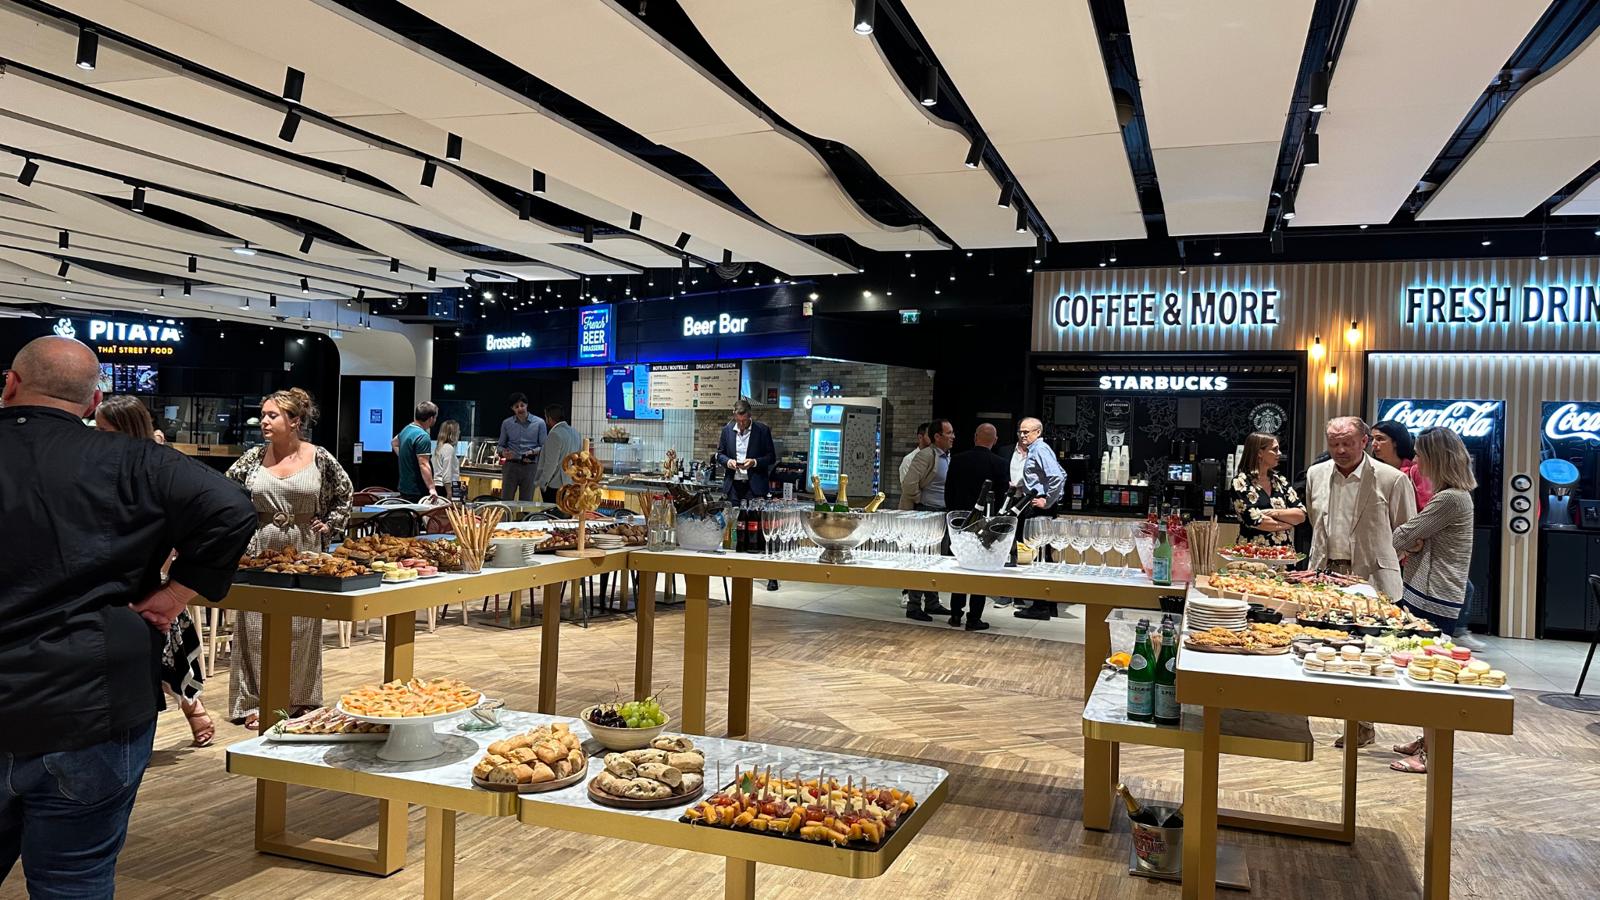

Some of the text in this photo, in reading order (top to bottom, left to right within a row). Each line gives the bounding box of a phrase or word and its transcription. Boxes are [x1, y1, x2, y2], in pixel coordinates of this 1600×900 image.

[1054, 290, 1278, 328] COFFEE & MORE
[1406, 286, 1511, 323] FRESH
[89, 320, 181, 341] PITAYA
[683, 313, 749, 337] Beer Bar
[486, 332, 532, 351] Brasserie
[583, 330, 605, 345] BEER
[118, 346, 148, 355] STREET
[150, 347, 174, 355] FOOD
[1099, 375, 1228, 391] STARBUCKS
